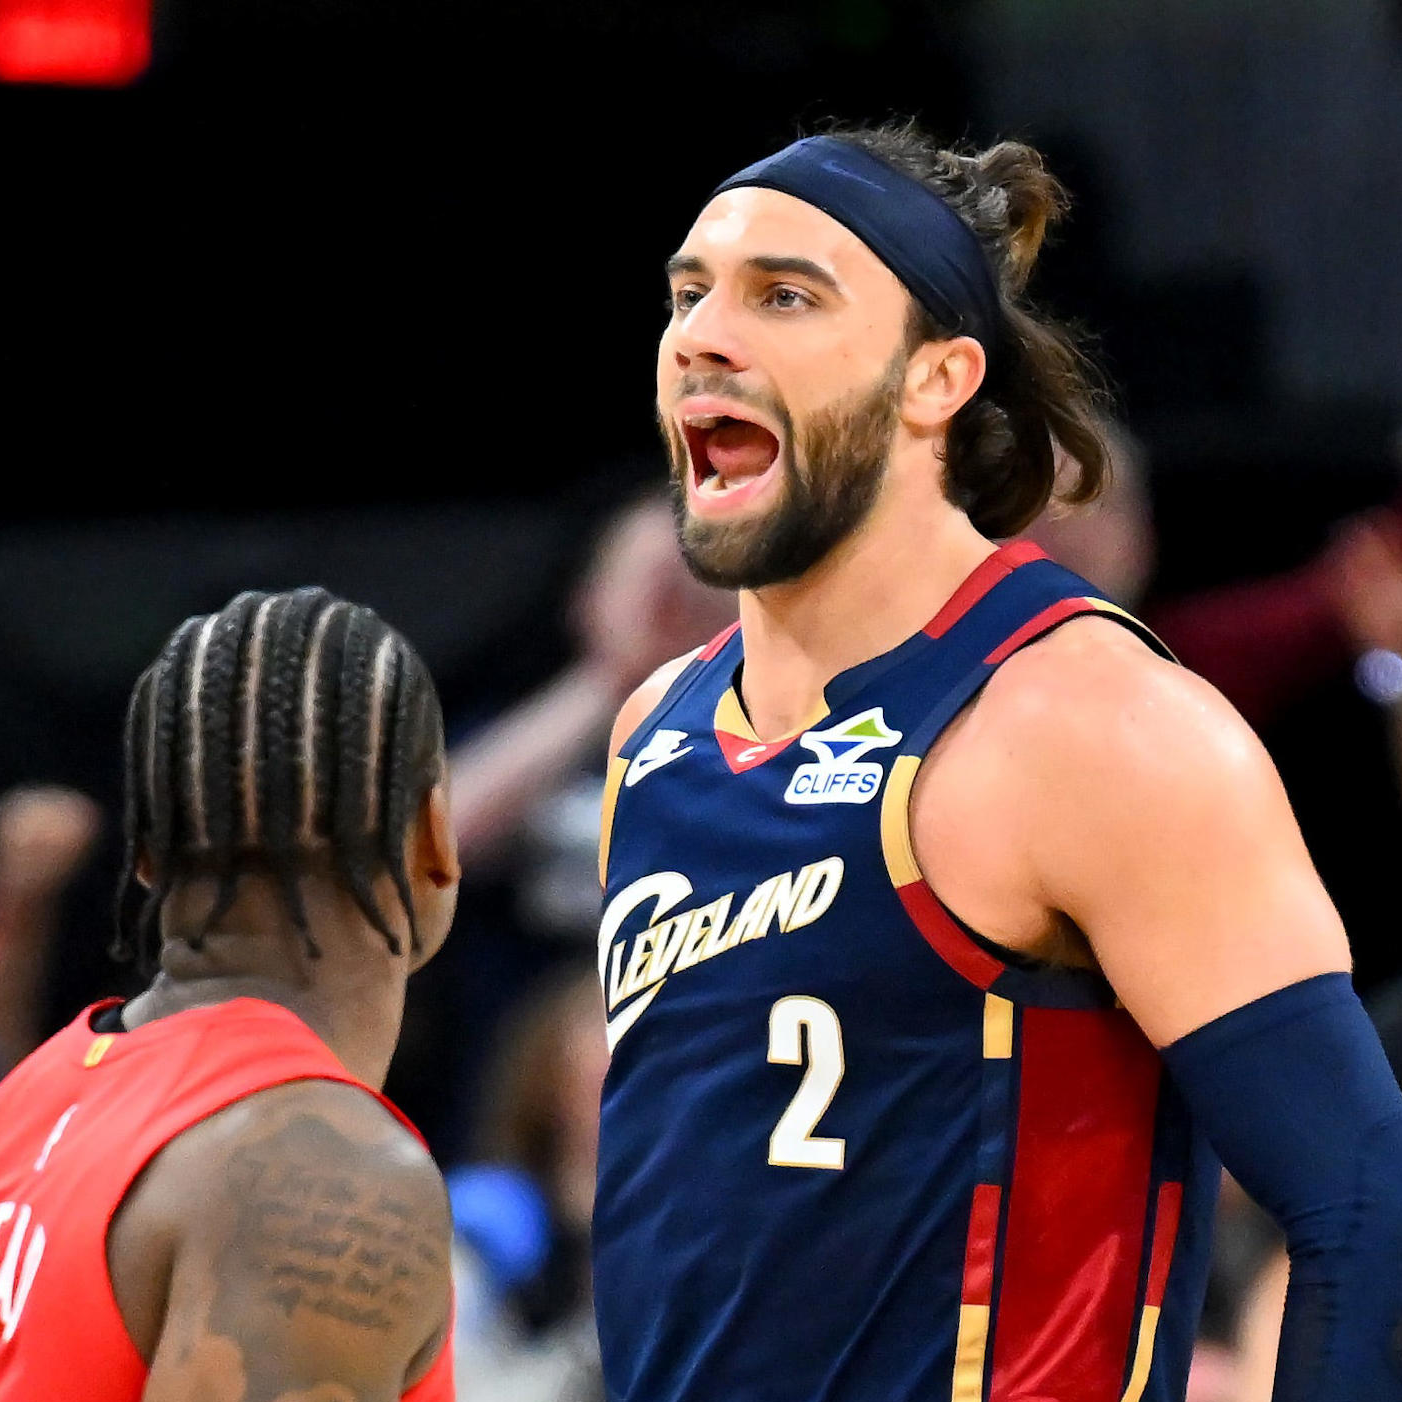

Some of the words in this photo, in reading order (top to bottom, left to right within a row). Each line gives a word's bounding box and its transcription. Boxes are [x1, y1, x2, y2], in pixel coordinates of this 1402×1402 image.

[793, 772, 878, 795] CLIFFS
[598, 856, 845, 1055] CLEVELAND
[767, 994, 846, 1170] 2
